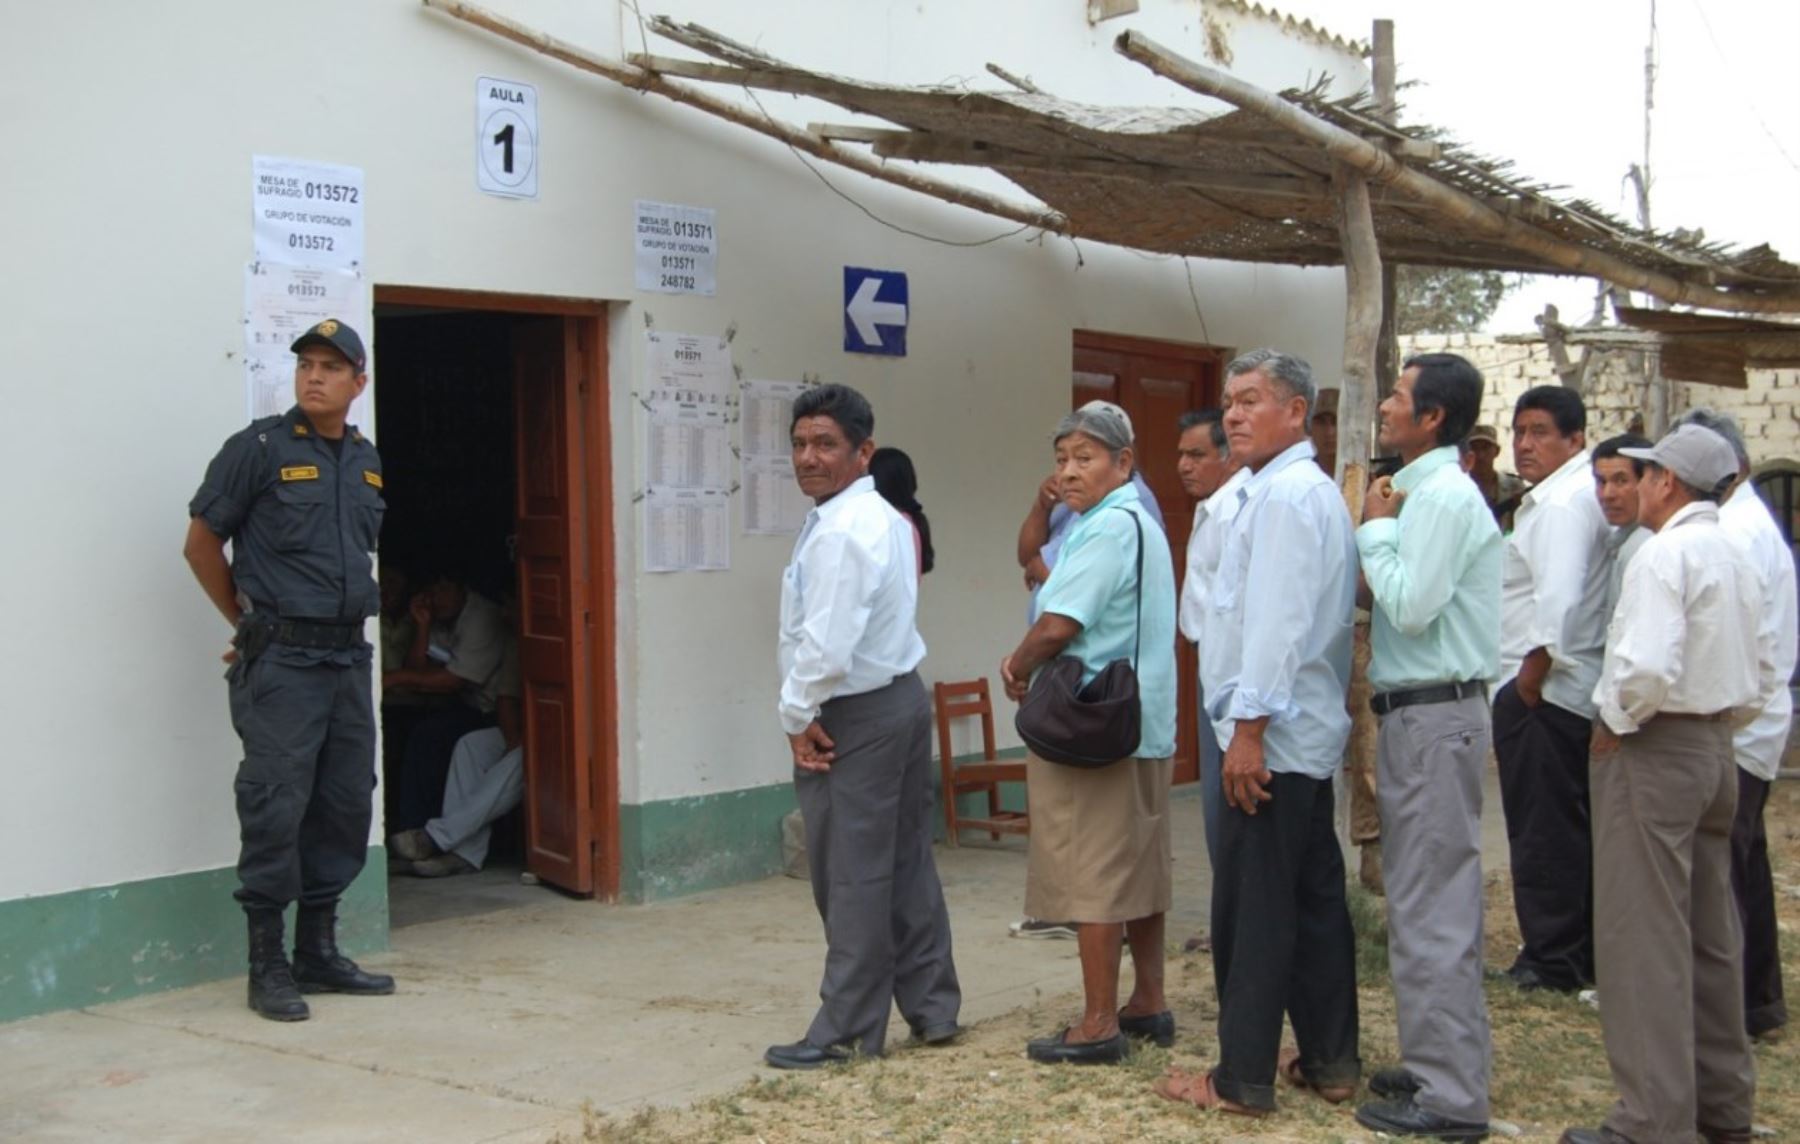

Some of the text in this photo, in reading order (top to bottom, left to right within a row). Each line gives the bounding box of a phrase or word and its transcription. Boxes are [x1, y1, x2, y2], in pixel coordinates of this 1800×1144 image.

[490, 87, 525, 104] AULA
[494, 124, 514, 174] 1
[260, 175, 299, 188] MESA DE
[258, 185, 303, 199] SUFRAGIO
[305, 182, 358, 204] 013572
[264, 209, 295, 221] GRUPO
[296, 212, 308, 223] DE
[639, 216, 669, 226] MESA DE
[638, 225, 672, 236] SUFRAGIO
[673, 221, 712, 240] 013571
[289, 233, 334, 252] 013572
[661, 255, 695, 271] 013571
[661, 274, 695, 290] 248782
